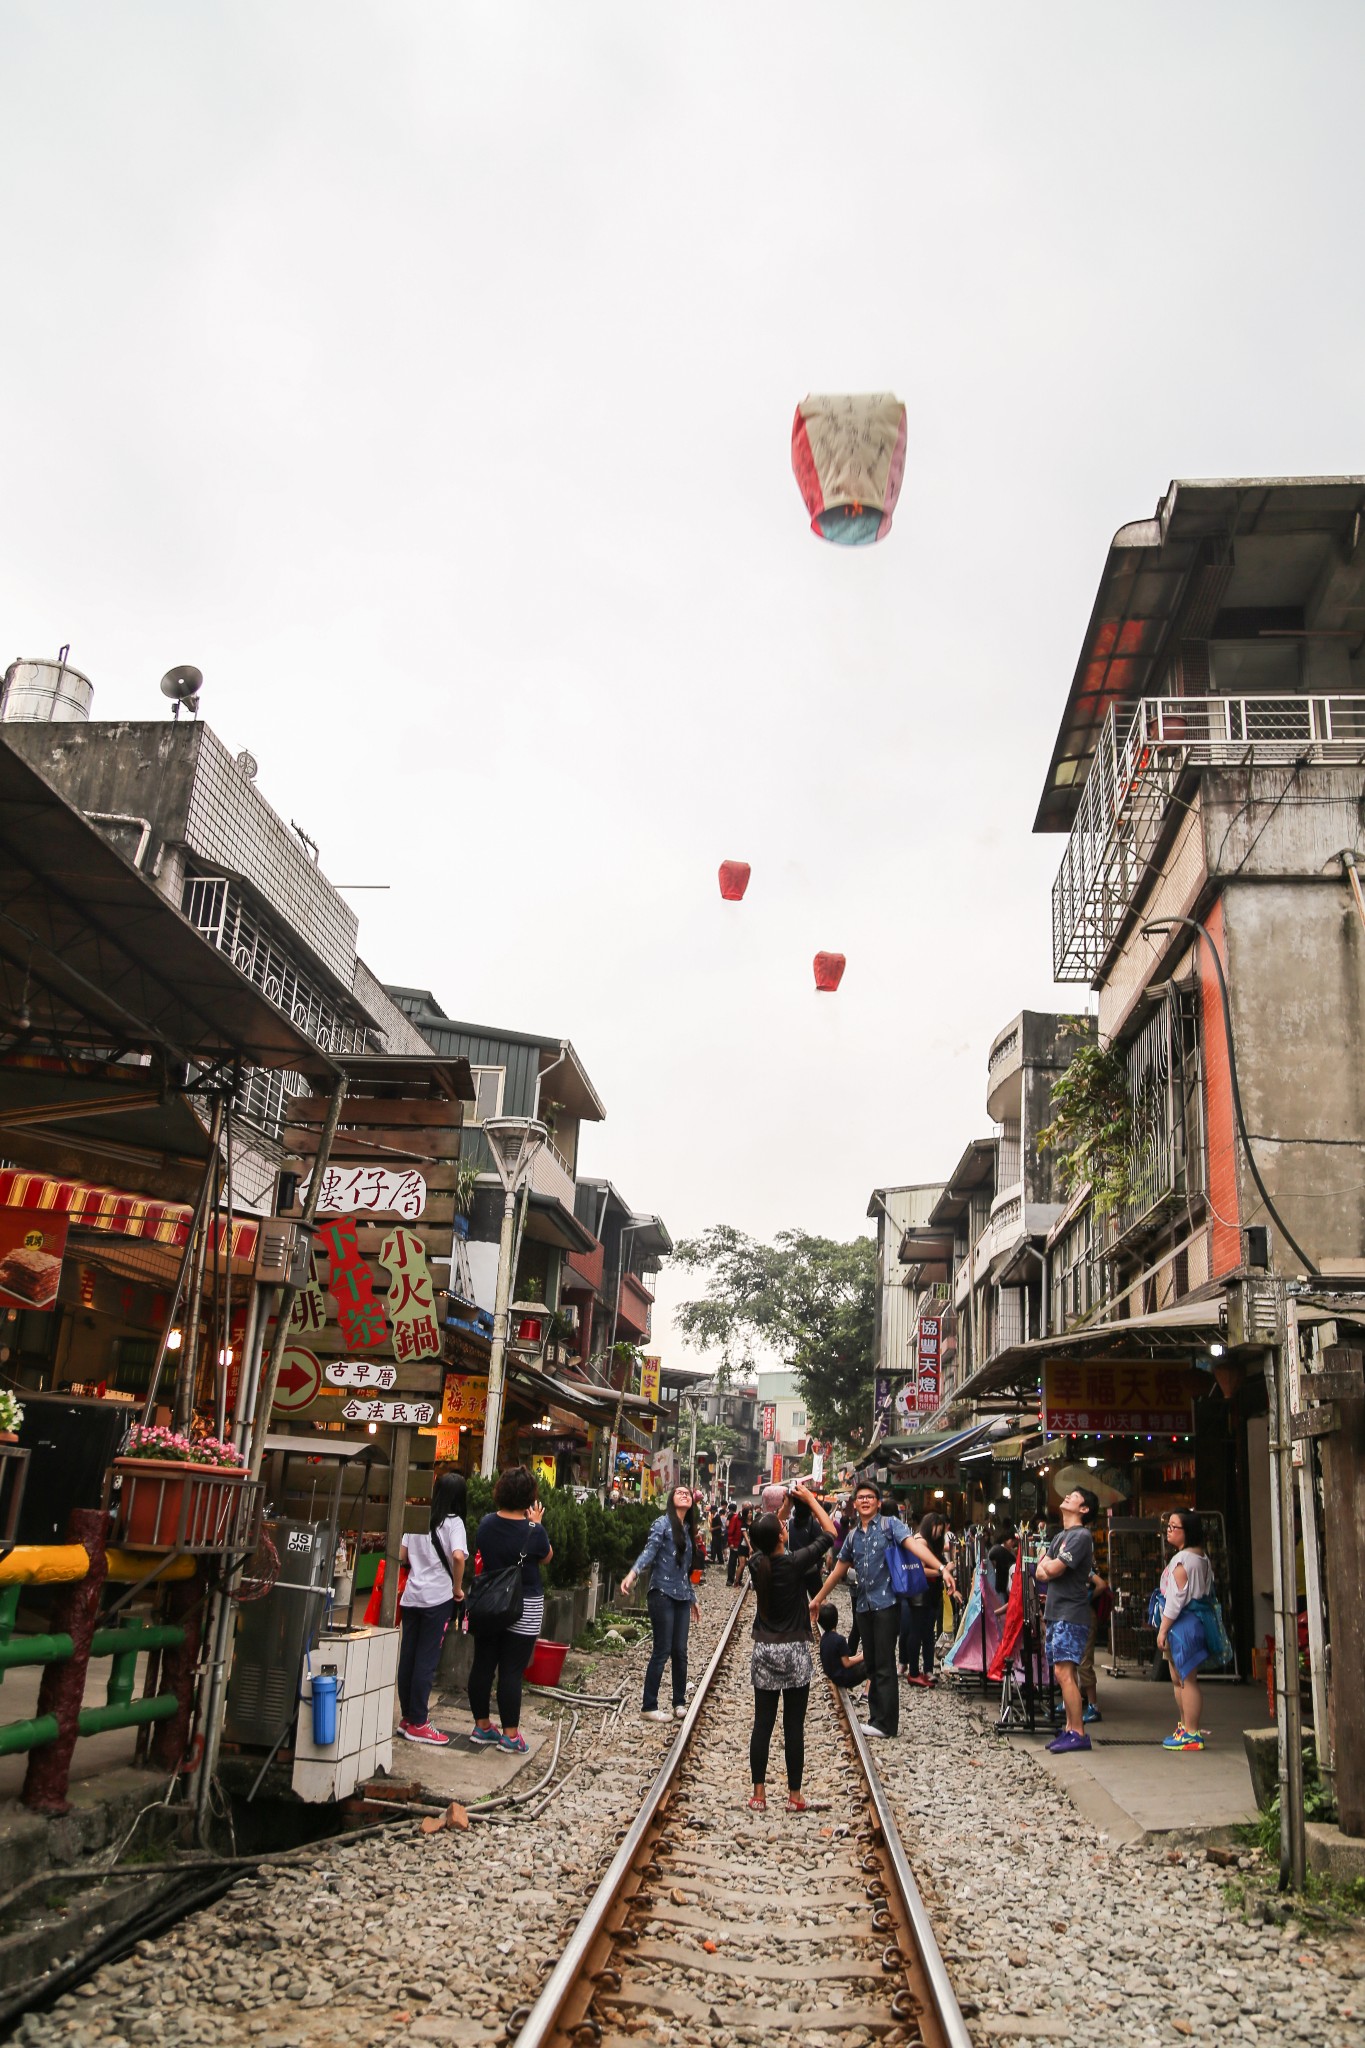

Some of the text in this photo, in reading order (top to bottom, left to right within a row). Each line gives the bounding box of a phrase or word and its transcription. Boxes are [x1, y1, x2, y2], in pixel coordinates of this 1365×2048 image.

[319, 1217, 385, 1345] 下午茶
[382, 1230, 440, 1361] 小火鍋
[919, 1319, 937, 1393] 協豐天燈
[332, 1362, 395, 1387] 古早厝
[1053, 1368, 1185, 1406] 幸福天燈
[343, 1401, 431, 1422] 合法民宿
[288, 1542, 310, 1552] ONE
[292, 1533, 309, 1544] JS
